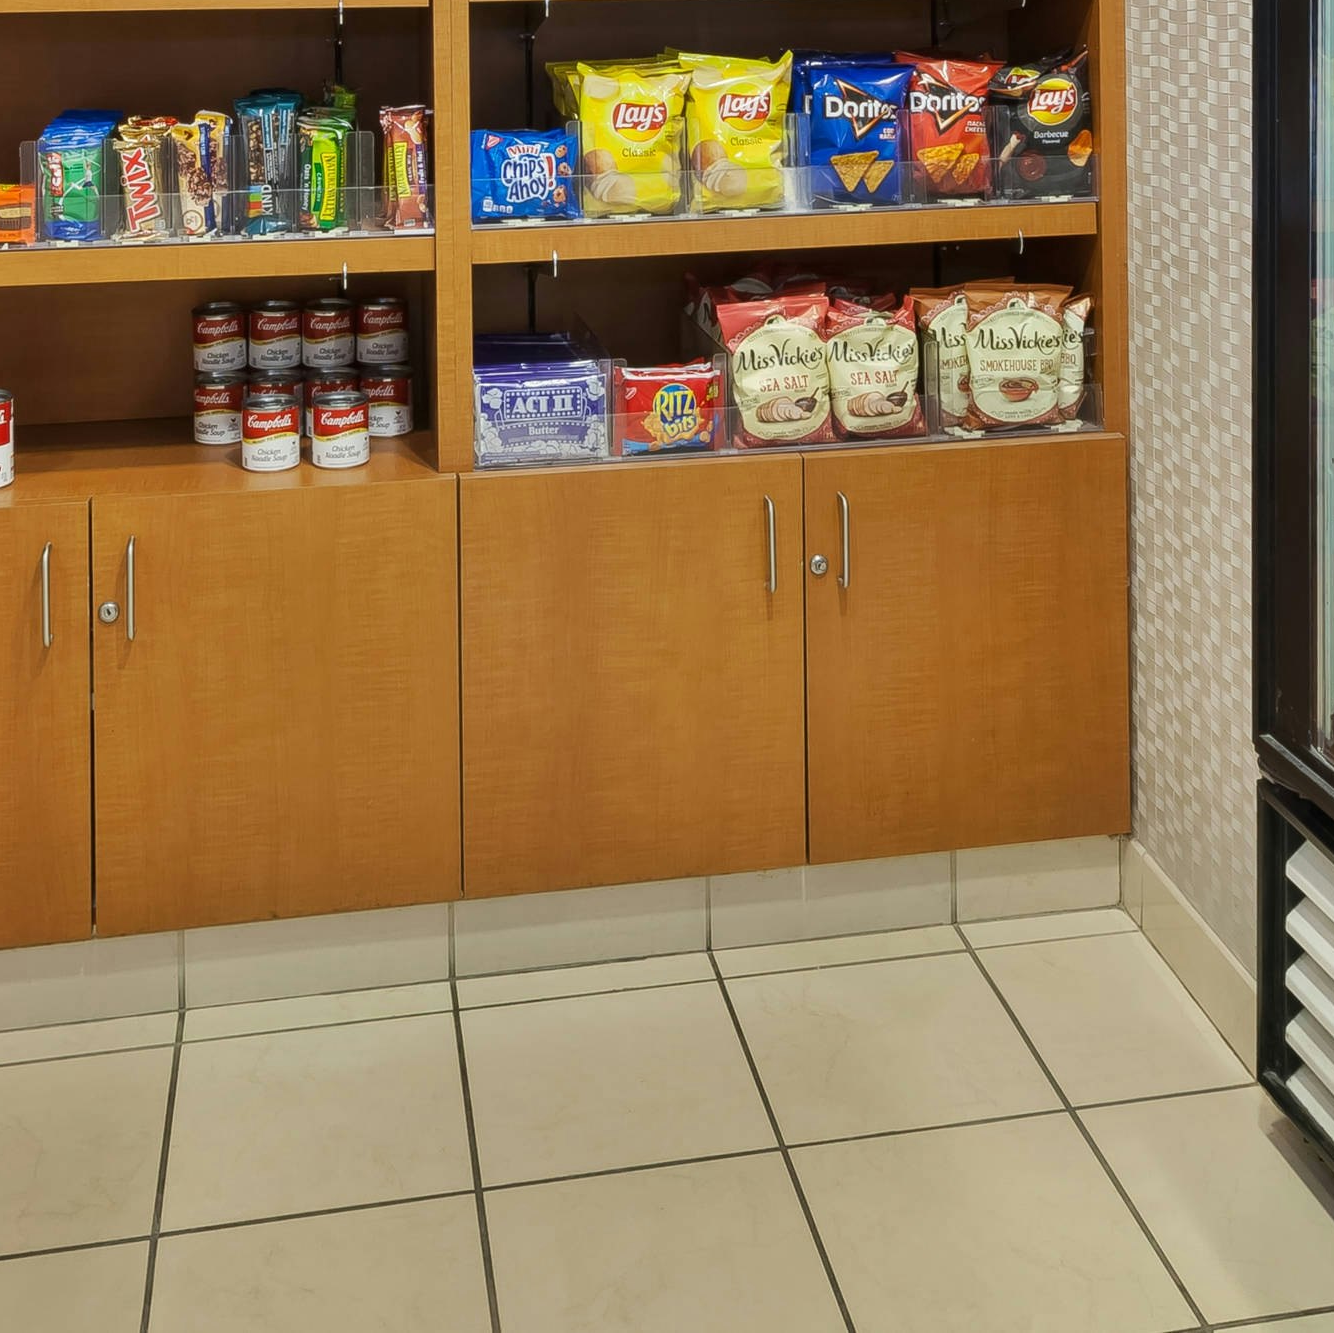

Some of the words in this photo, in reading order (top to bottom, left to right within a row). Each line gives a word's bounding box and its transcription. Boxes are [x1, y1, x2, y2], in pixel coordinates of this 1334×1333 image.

[722, 92, 768, 121] Lay's
[825, 96, 897, 119] Doritos
[909, 92, 986, 113] Doritos
[1031, 87, 1076, 114] Lay's
[617, 103, 665, 131] Lay's
[730, 137, 762, 147] Classic
[1033, 130, 1069, 140] Barbecue
[507, 144, 539, 156] Mini
[622, 147, 656, 158] Classic
[503, 159, 545, 181] Chips
[122, 148, 161, 233] TWIX
[261, 184, 274, 216] KIND
[976, 327, 1014, 350] Miss
[1012, 325, 1061, 350] Vickie's
[736, 348, 775, 374] Miss
[774, 339, 824, 366] Vickie's
[828, 339, 869, 364] Miss
[867, 338, 916, 365] Vickie's
[979, 359, 1038, 372] SMOKEHOUSE
[1040, 358, 1055, 372] BBQ
[759, 378, 781, 392] SEA
[784, 375, 809, 390] SALT
[850, 372, 871, 385] SEA
[875, 369, 899, 384] SALT
[513, 396, 550, 414] ACT
[551, 395, 574, 411] II
[655, 390, 695, 418] RITZ
[248, 414, 292, 431] Campbell's
[321, 412, 364, 428] Campbell's
[662, 416, 695, 438] bits
[528, 425, 560, 436] Butter
[257, 448, 281, 456] Chicken
[331, 445, 355, 453] Chicken
